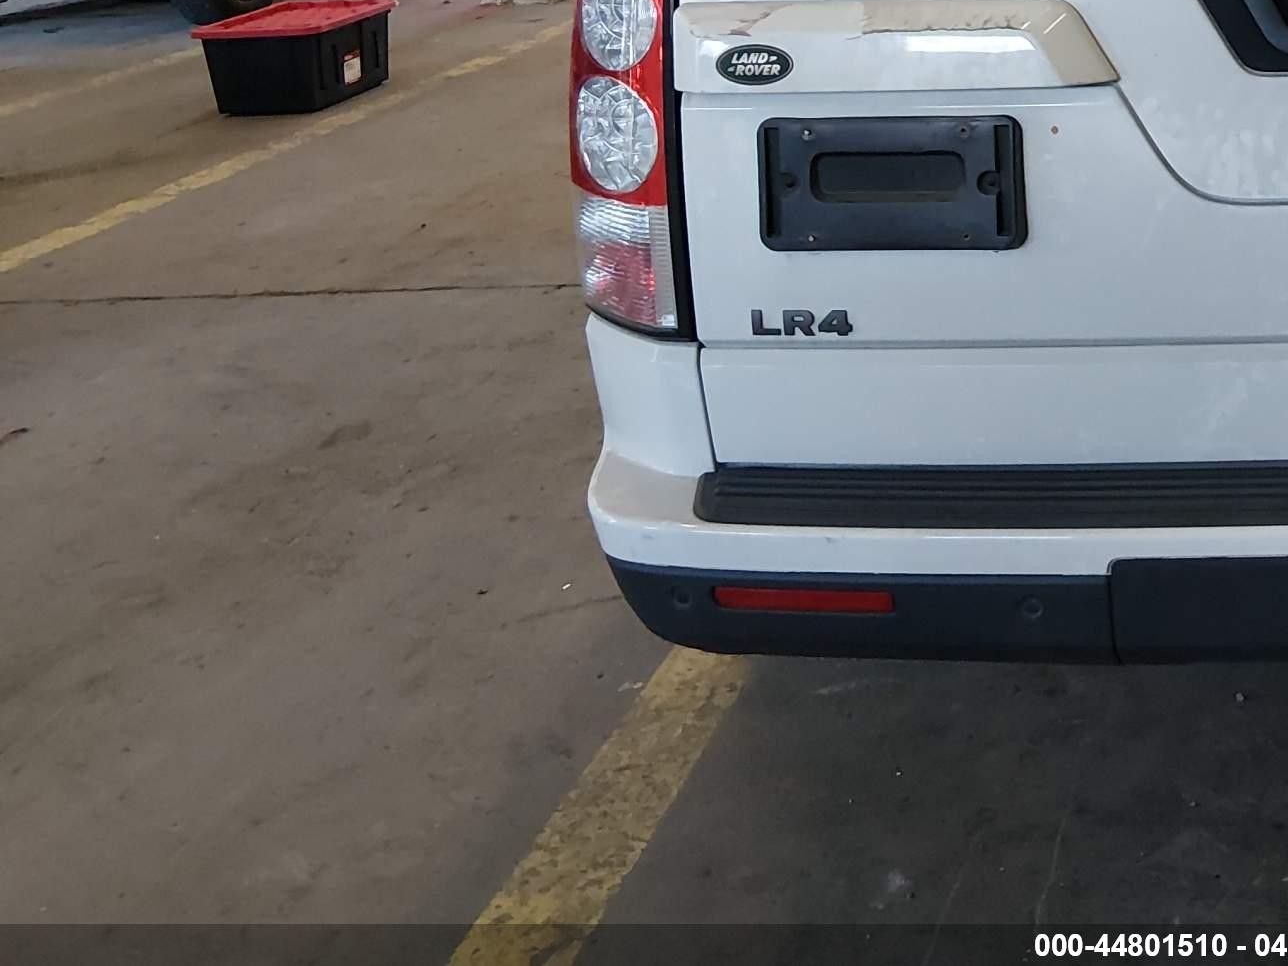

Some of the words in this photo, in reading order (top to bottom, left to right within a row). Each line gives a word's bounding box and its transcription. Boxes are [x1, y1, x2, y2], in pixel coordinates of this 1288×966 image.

[731, 52, 770, 64] LAND
[735, 64, 781, 76] ROVER
[751, 309, 854, 337] LR4
